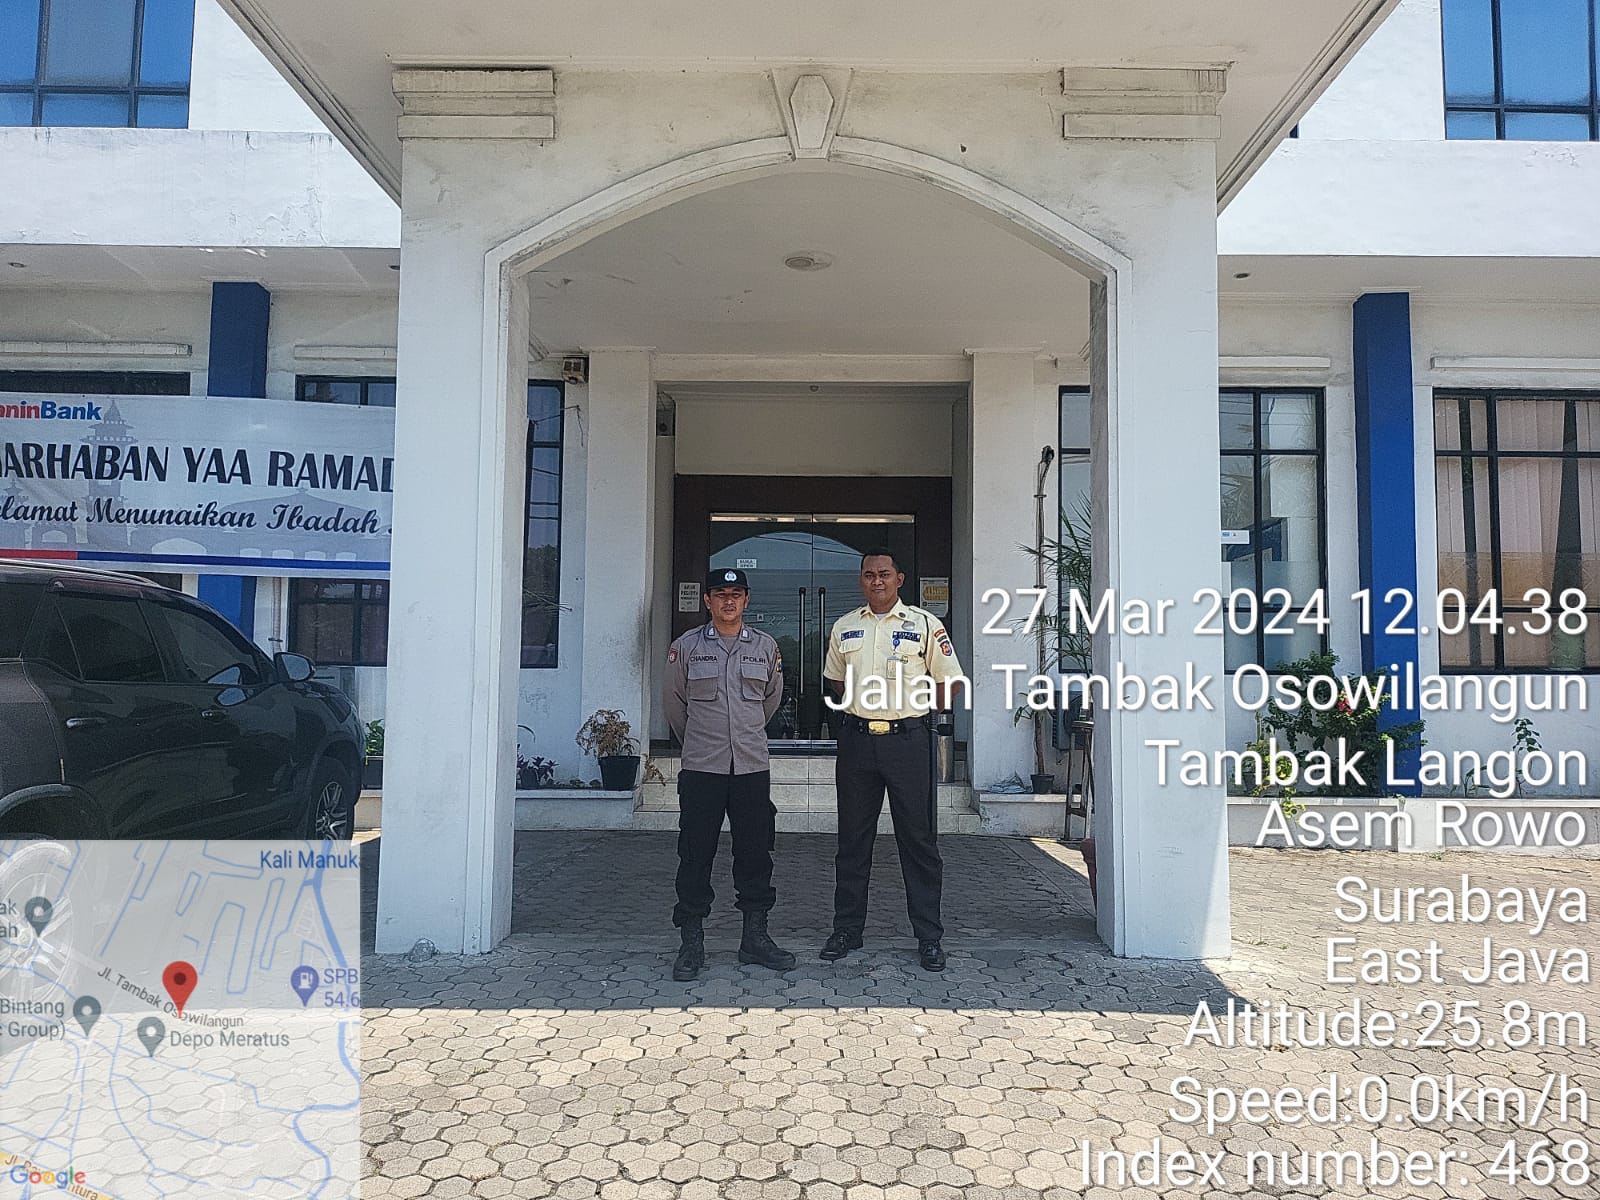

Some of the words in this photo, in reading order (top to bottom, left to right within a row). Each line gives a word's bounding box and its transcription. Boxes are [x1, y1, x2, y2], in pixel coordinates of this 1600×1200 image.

[0, 443, 169, 482] ARHABAN
[183, 447, 252, 486] YAA
[0, 496, 79, 522] lamat
[86, 498, 257, 528] Menunaikan
[266, 504, 380, 534] Ibadah
[689, 655, 718, 663] CHANDRA
[742, 655, 766, 665] POLRI
